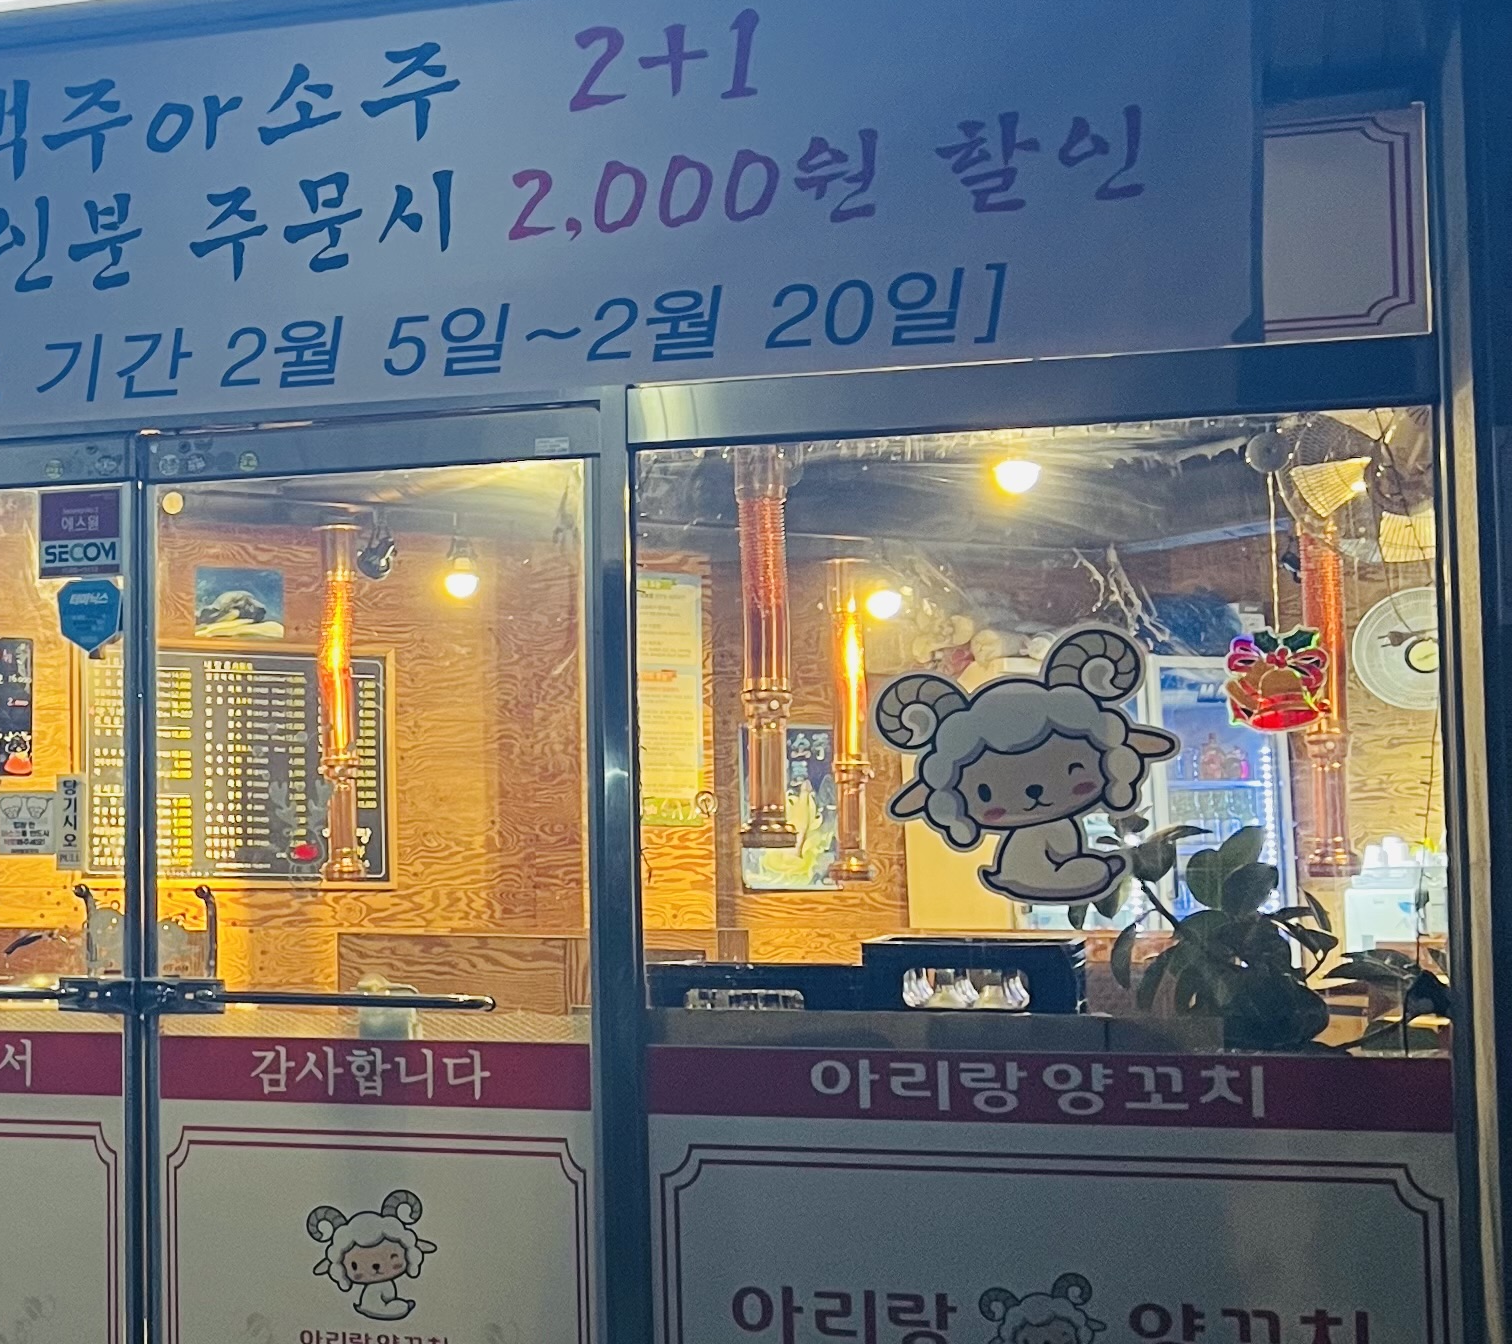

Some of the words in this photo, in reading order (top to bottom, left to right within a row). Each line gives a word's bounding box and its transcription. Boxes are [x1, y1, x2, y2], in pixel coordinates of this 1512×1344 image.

[568, 7, 761, 113] 2+1
[190, 170, 454, 282] 주문시
[508, 128, 879, 243] 2,000원
[935, 104, 1145, 214] 할인
[34, 327, 193, 404] 기간
[220, 314, 343, 389] 2월
[383, 284, 723, 378] 5일~2월
[765, 262, 1009, 350] 20일]
[44, 542, 117, 564] SECOM
[62, 779, 78, 848] 당기시오
[250, 1045, 492, 1101] 감사합니다
[809, 1057, 1266, 1120] 아리랑양꼬치
